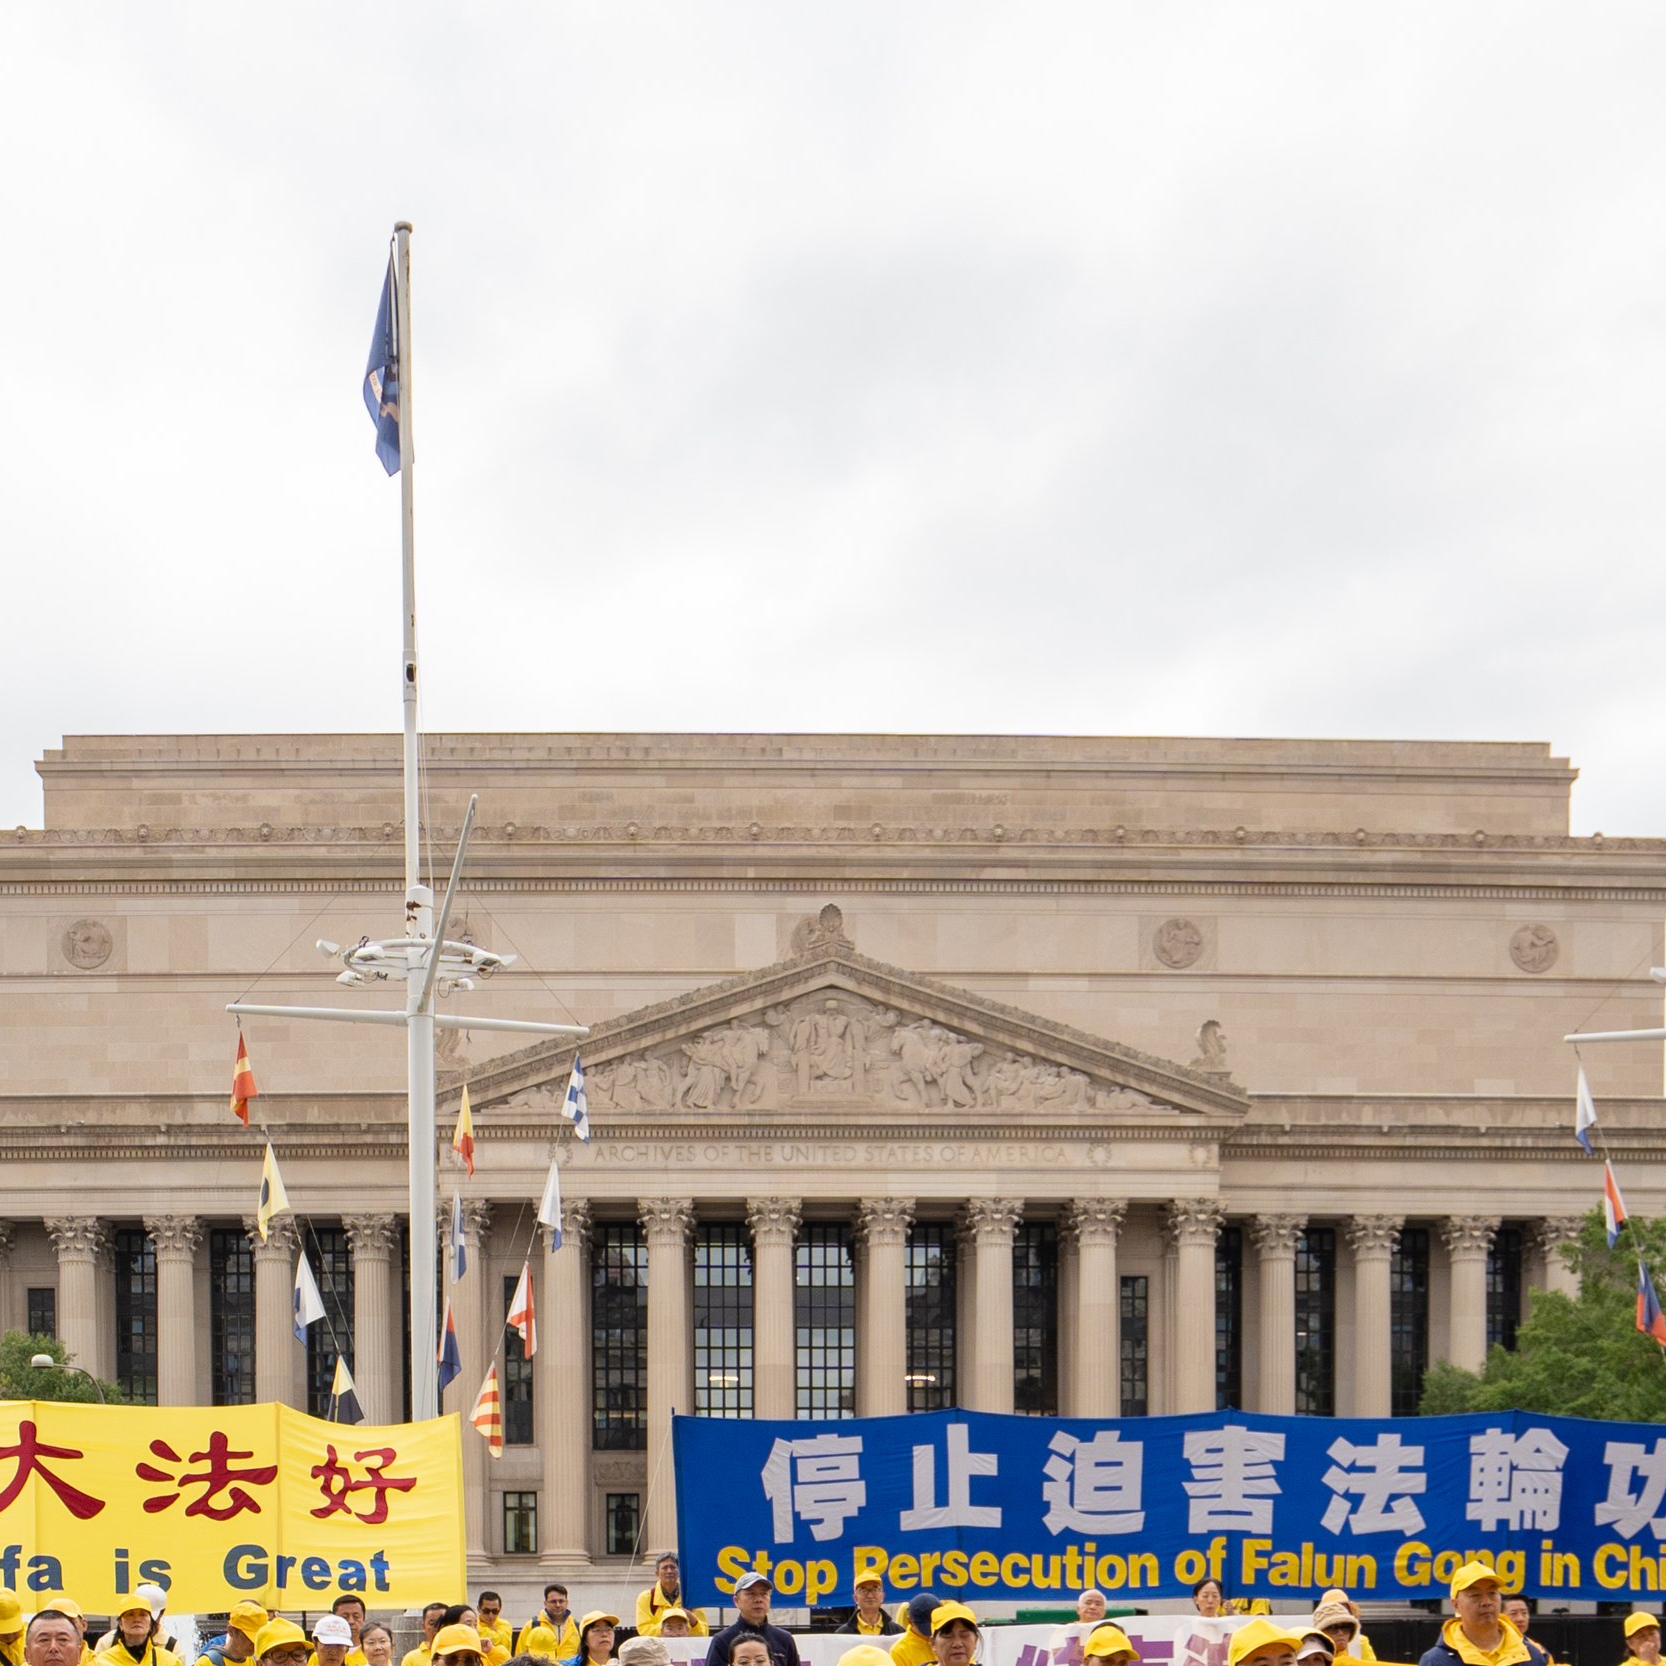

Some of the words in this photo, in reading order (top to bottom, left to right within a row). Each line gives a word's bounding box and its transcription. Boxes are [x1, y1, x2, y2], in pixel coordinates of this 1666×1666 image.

[594, 1144, 697, 1163] ARCHIVES
[703, 1144, 729, 1162] OF
[734, 1144, 773, 1162] THE
[780, 1144, 857, 1163] UNITED
[864, 1144, 933, 1163] STATES
[939, 1145, 966, 1162] OF
[970, 1145, 1067, 1164] AMERICA
[114, 1547, 172, 1594] is
[223, 1544, 390, 1592] Great
[714, 1545, 838, 1605] Stop
[853, 1540, 1161, 1591] Persecution
[1174, 1536, 1227, 1586] of
[1241, 1537, 1377, 1589] Falun
[1540, 1539, 1581, 1588] in
